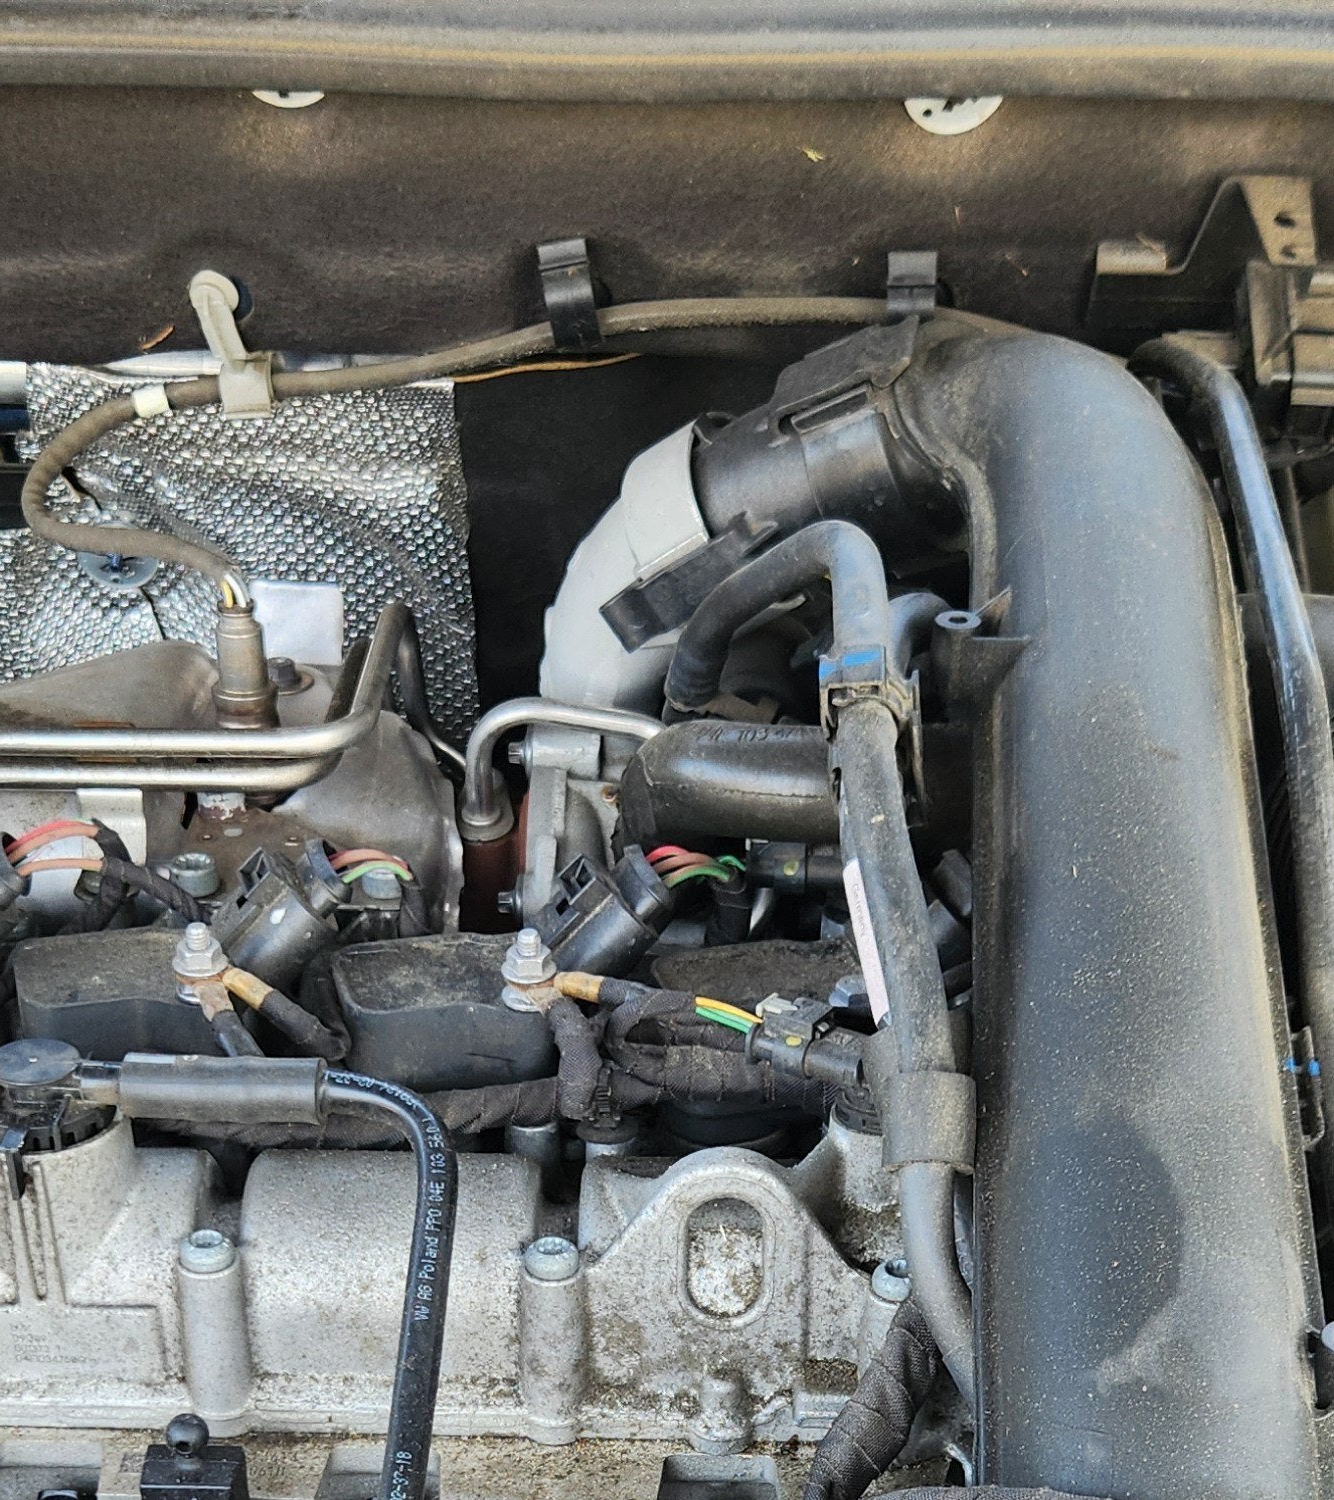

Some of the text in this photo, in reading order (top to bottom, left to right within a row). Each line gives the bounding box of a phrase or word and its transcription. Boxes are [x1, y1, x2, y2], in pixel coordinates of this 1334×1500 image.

[431, 1151, 448, 1175] 103
[418, 1236, 440, 1281] Poland
[417, 1282, 433, 1301] AG
